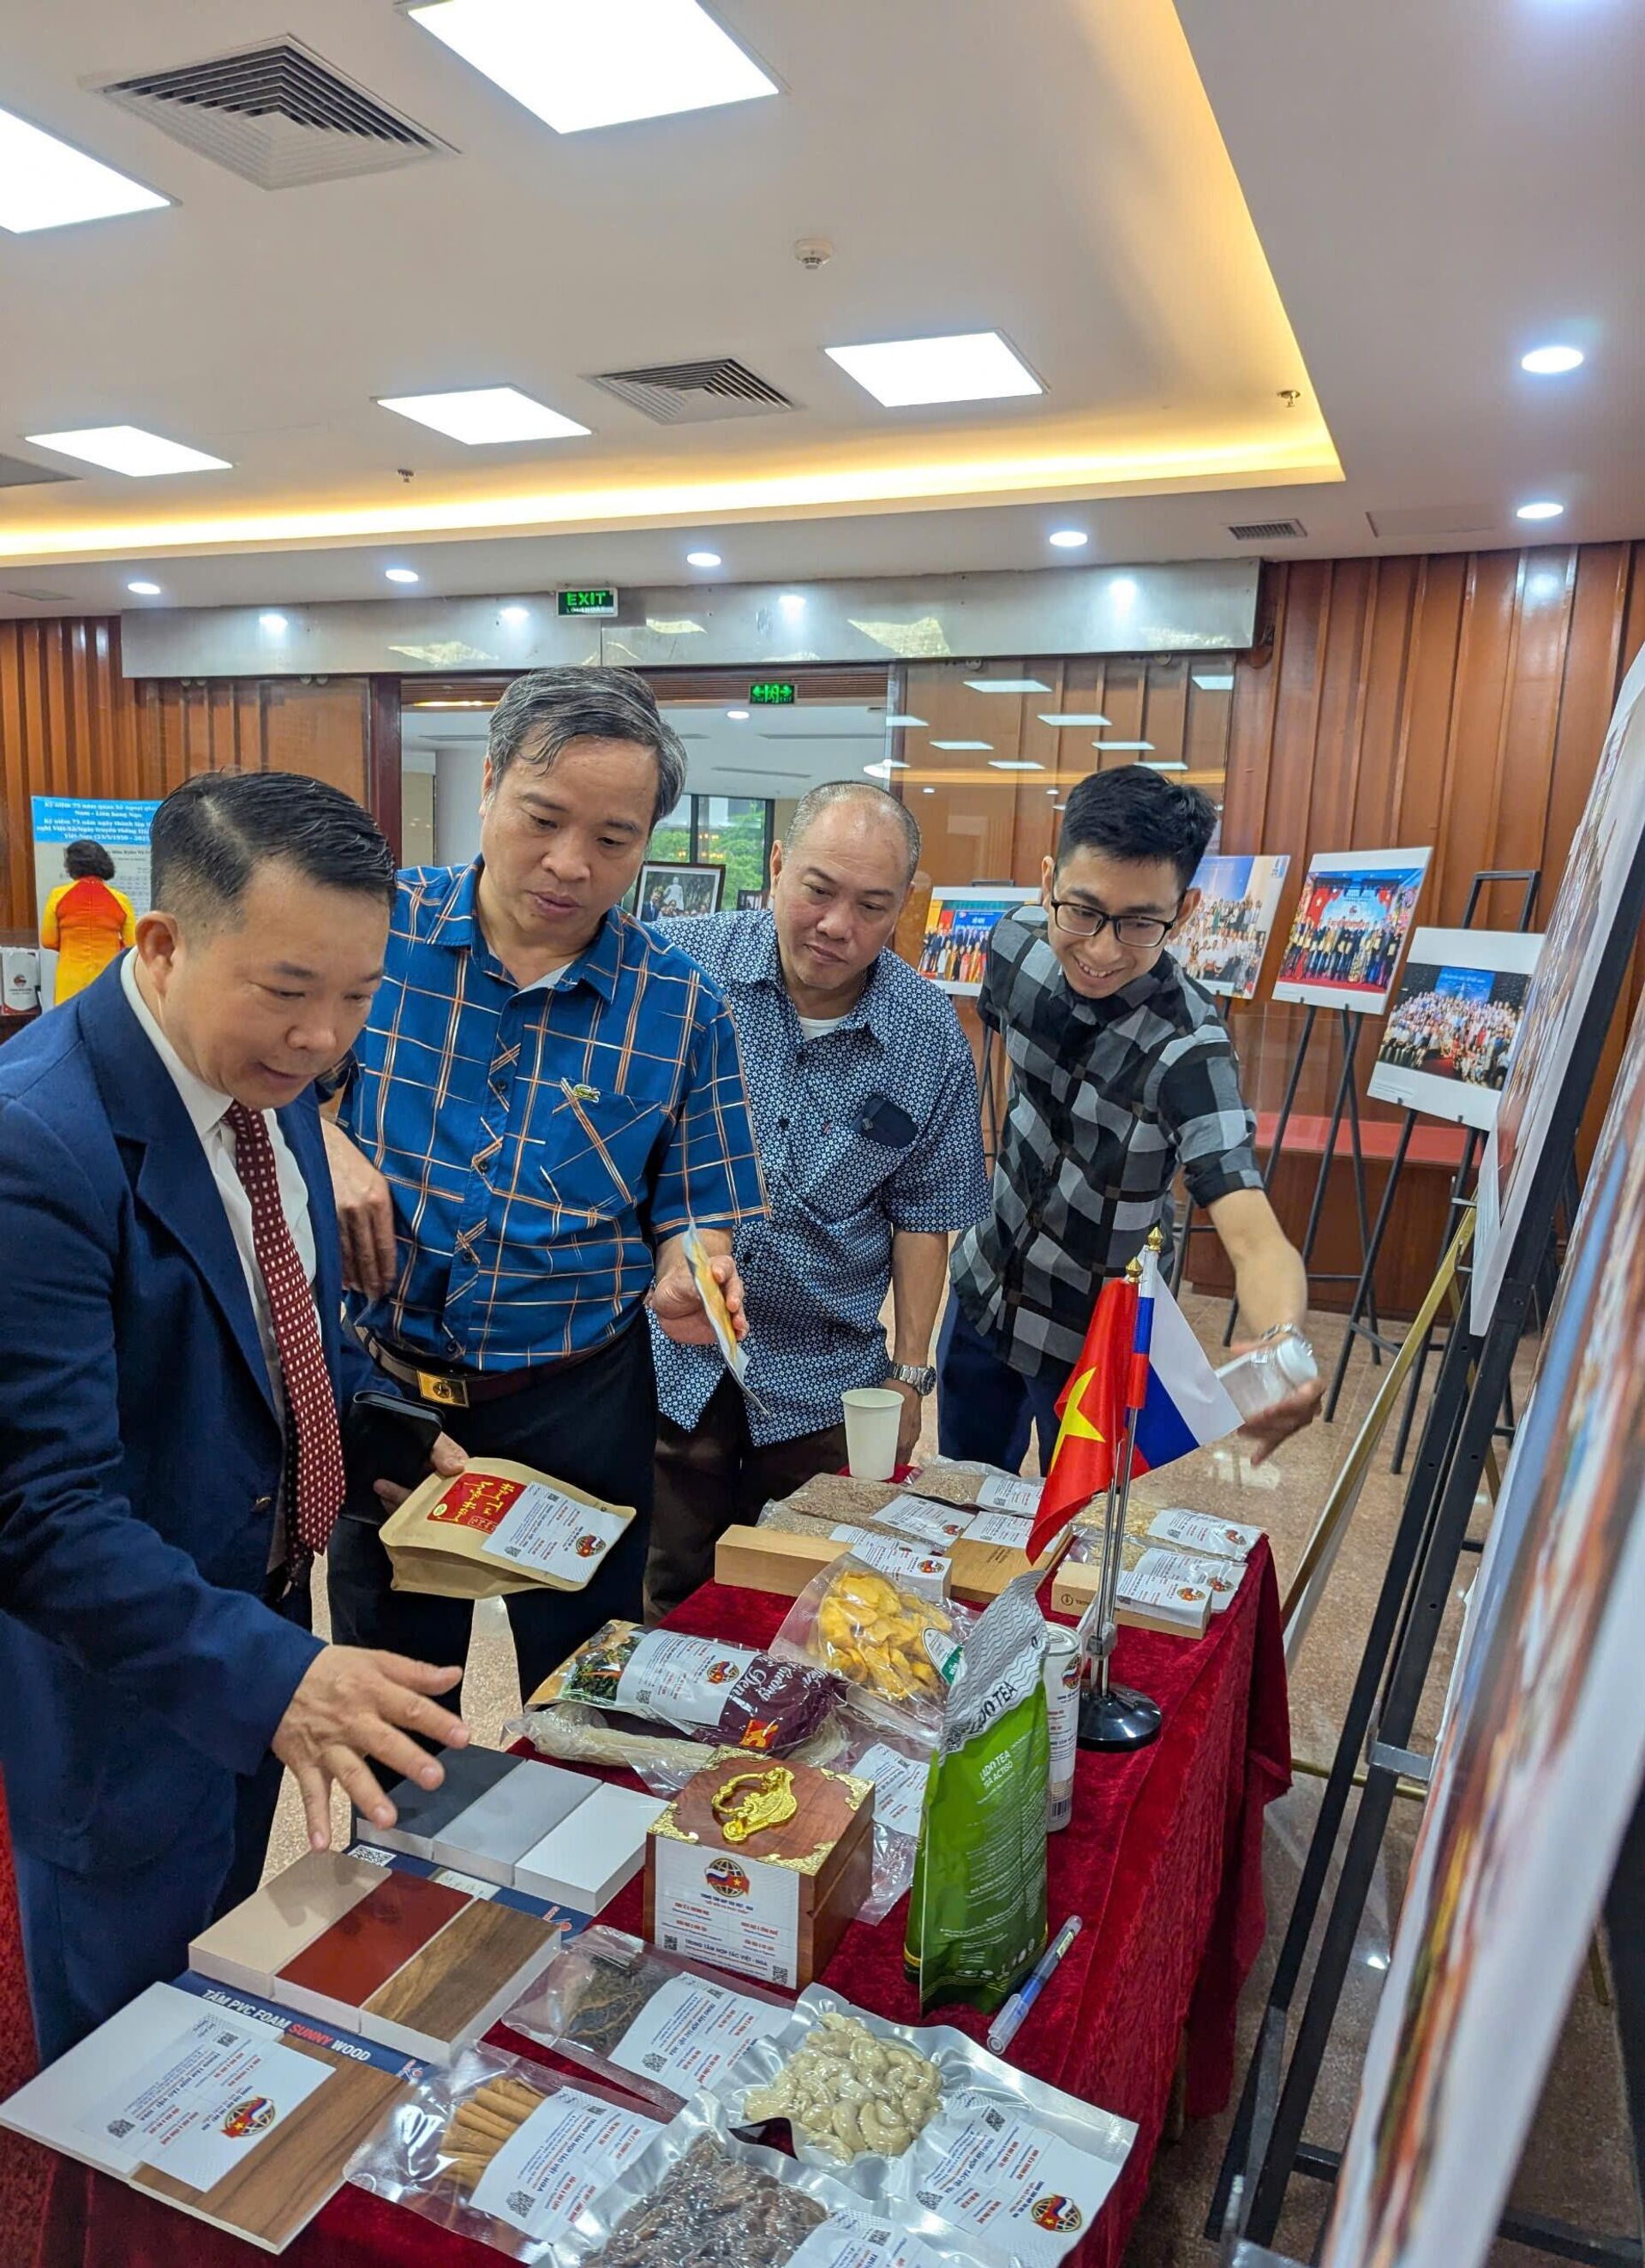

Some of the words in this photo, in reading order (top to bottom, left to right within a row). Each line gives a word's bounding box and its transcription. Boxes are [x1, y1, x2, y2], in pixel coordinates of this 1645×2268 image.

[566, 591, 606, 606] EXIT
[731, 1666, 767, 1697] Đen
[993, 1681, 1018, 1710] TEA
[996, 1750, 1012, 1767] TEA
[201, 1989, 229, 2008] TẤM
[227, 2000, 256, 2017] PVC
[254, 2009, 292, 2029] FOAM
[289, 2023, 333, 2046] SUNNY
[331, 2040, 371, 2062] WOOD
[582, 2116, 596, 2133] TRUNG
[573, 2131, 586, 2144] TÂM
[565, 2141, 577, 2154] HỢP
[556, 2151, 569, 2164] TÁC
[548, 2162, 560, 2175] VIỆT
[535, 2175, 550, 2193] NGA
